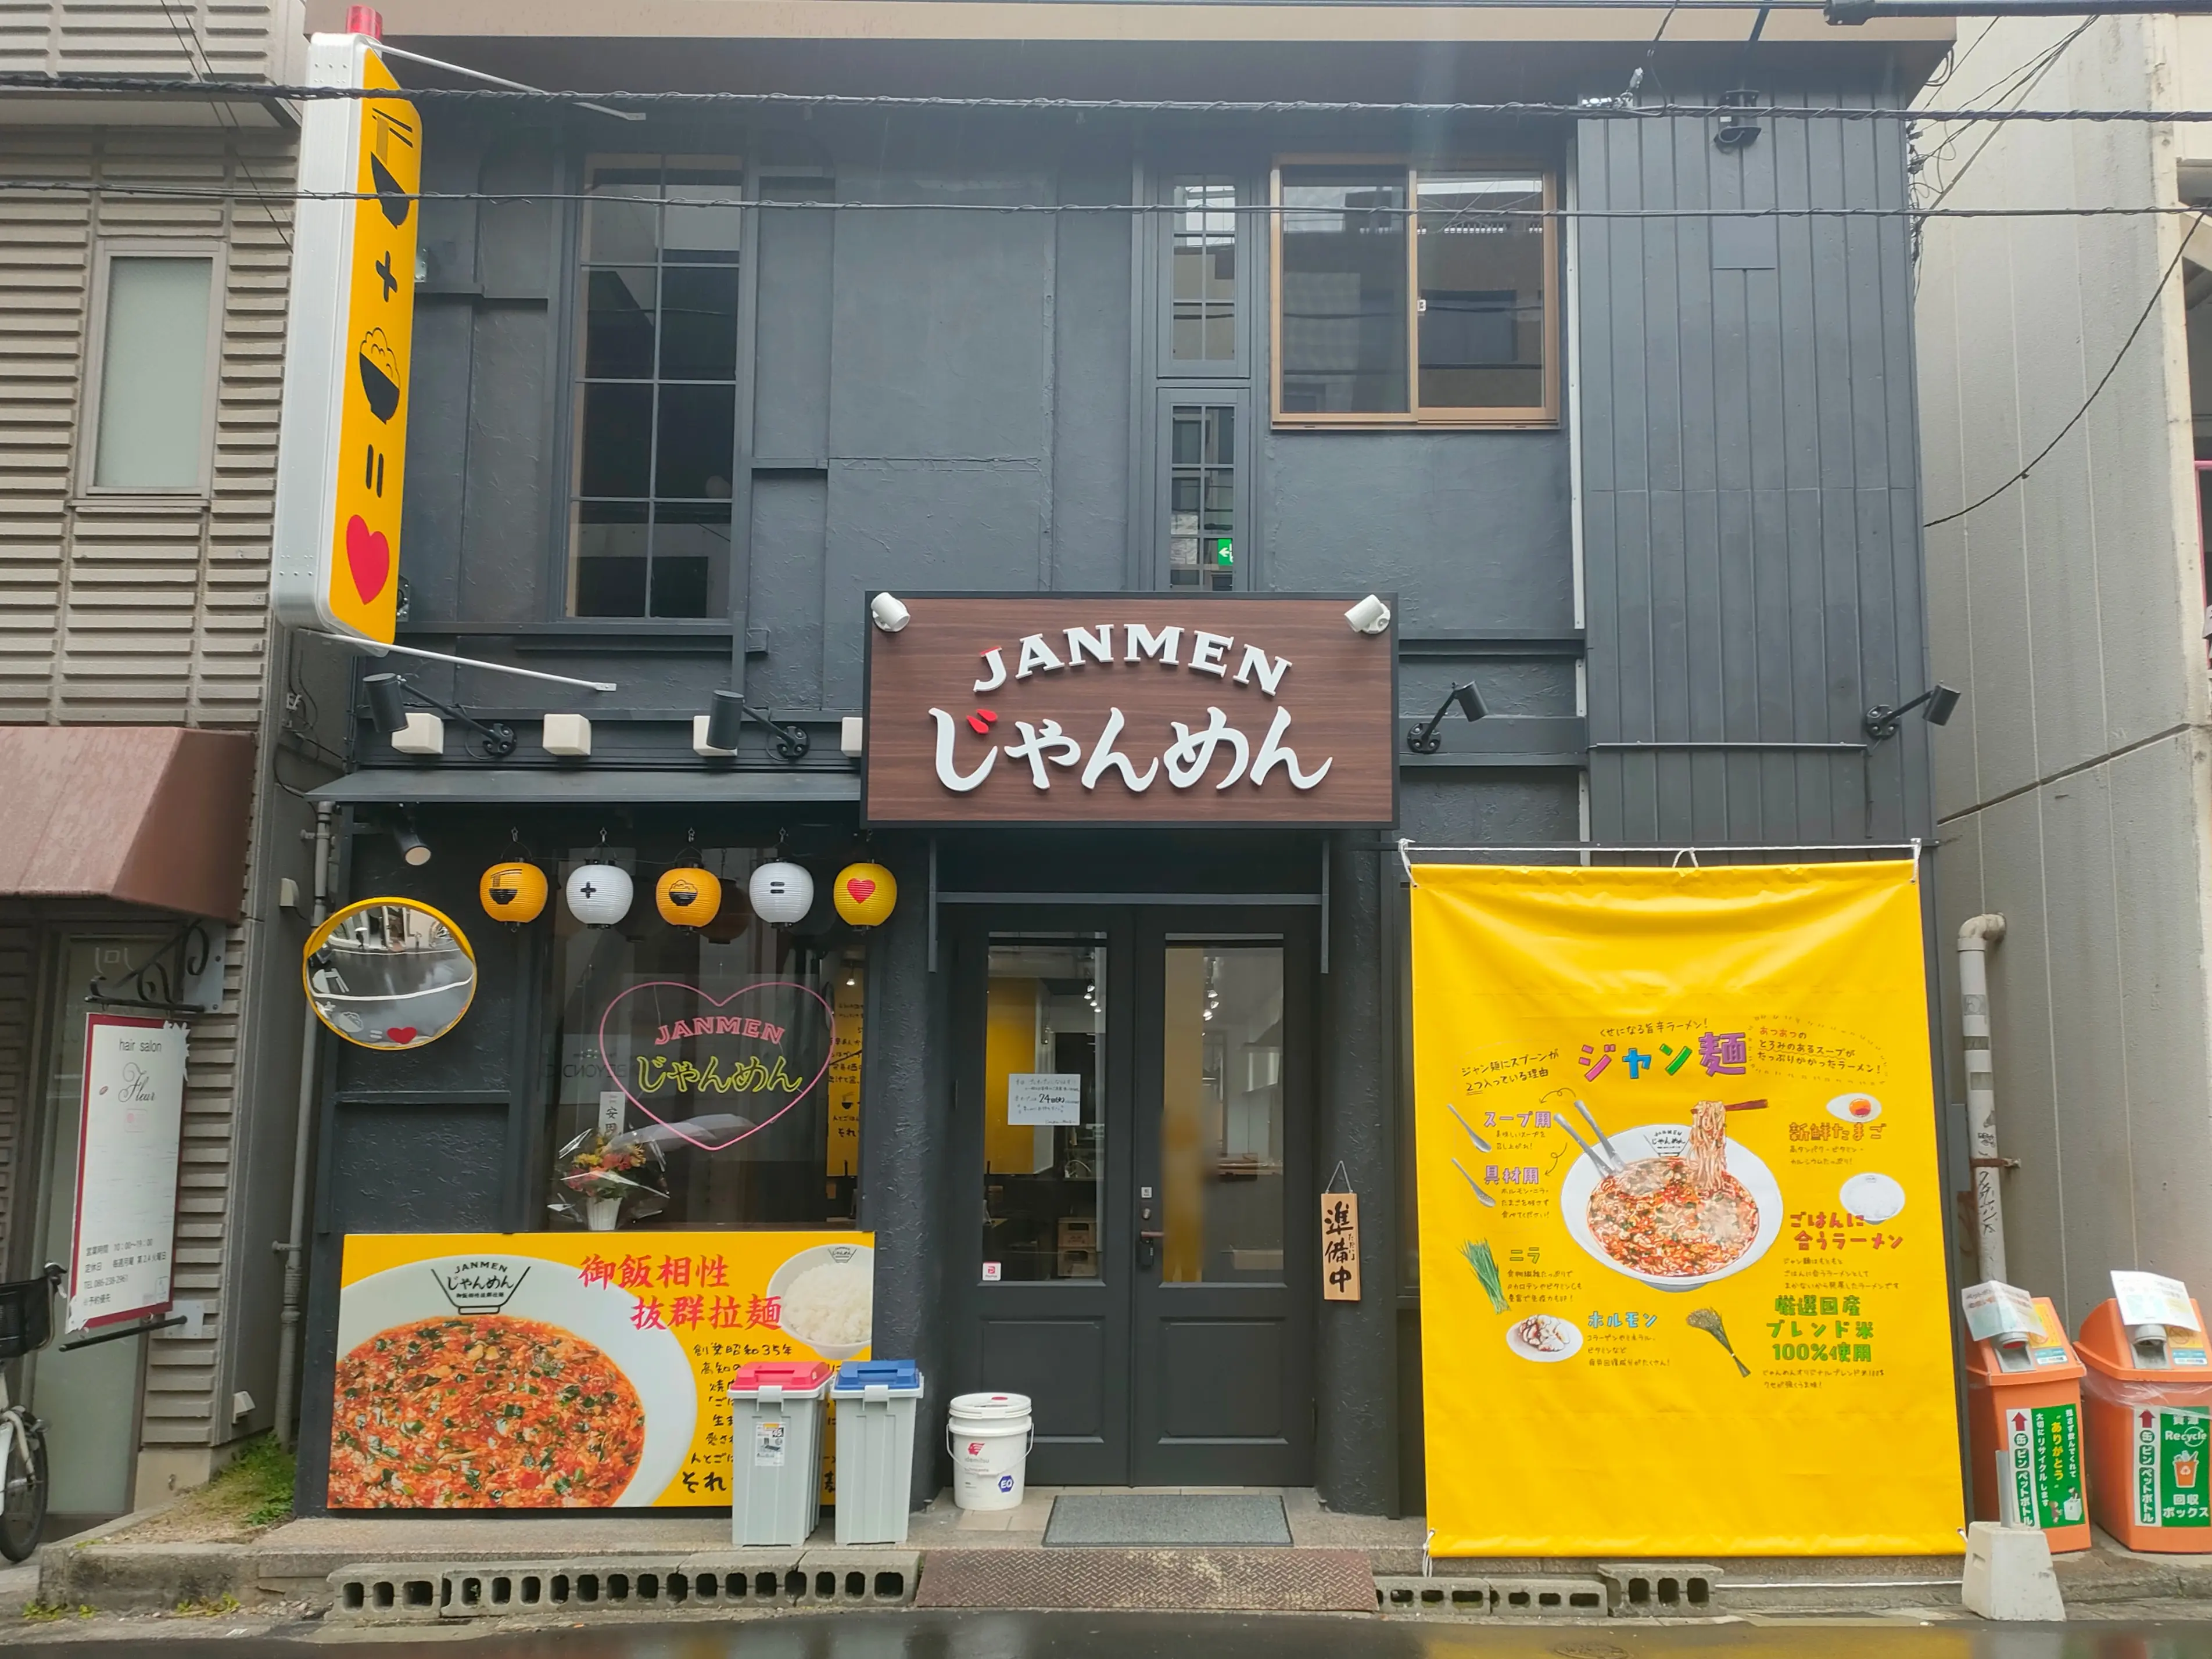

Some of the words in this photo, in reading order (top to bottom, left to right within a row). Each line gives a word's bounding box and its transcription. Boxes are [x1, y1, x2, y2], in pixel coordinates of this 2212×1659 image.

[973, 624, 1292, 696] JANMEN
[928, 706, 1333, 792] じゃんめん
[655, 1016, 785, 1045] JANMEN
[1759, 1026, 1807, 1039] あつあつの
[119, 1038, 135, 1051] hair
[139, 1040, 162, 1052] salon
[1759, 1040, 1855, 1057] とろみのあるスープが
[1462, 1048, 1559, 1076] ジャン麺にスプーンが
[1578, 1032, 1747, 1082] ジャン麺
[118, 1062, 155, 1103] Fleur
[637, 1055, 803, 1093] じゃんめん
[1466, 1067, 1548, 1091] 2つ入っている理由
[1483, 1111, 1551, 1128] スープ用
[1789, 1122, 1887, 1142] 新鮮たまご
[1484, 1165, 1539, 1185] 具材用
[1790, 1211, 1865, 1229] ごはんに
[1325, 1201, 1354, 1293] 準備中
[1794, 1230, 1903, 1251] 合うラーメン
[1510, 1247, 1540, 1264] ニラ
[455, 1262, 508, 1274] JANMEN
[577, 1254, 730, 1291] 御飯相性
[447, 1275, 514, 1290] じゃんめん
[630, 1294, 782, 1331] 抜群拉麺
[1775, 1294, 1860, 1316] 厳選国産
[1588, 1310, 1657, 1328] ホルモン
[1766, 1319, 1874, 1340] ブレンド米
[693, 1342, 793, 1356] 創業昭和35年
[1772, 1342, 1872, 1362] 100%使用
[2164, 1430, 2207, 1442] Recycle
[2017, 1450, 2027, 1468] ビン
[2036, 1413, 2049, 1507] 大切にリサイクルします
[2142, 1446, 2153, 1464] ビン
[1001, 1479, 1012, 1488] EO
[2018, 1472, 2033, 1526] ペットボトル
[2142, 1468, 2154, 1523] ペットボトル
[2172, 1493, 2200, 1506] 回収
[2163, 1507, 2210, 1518] ボックス
